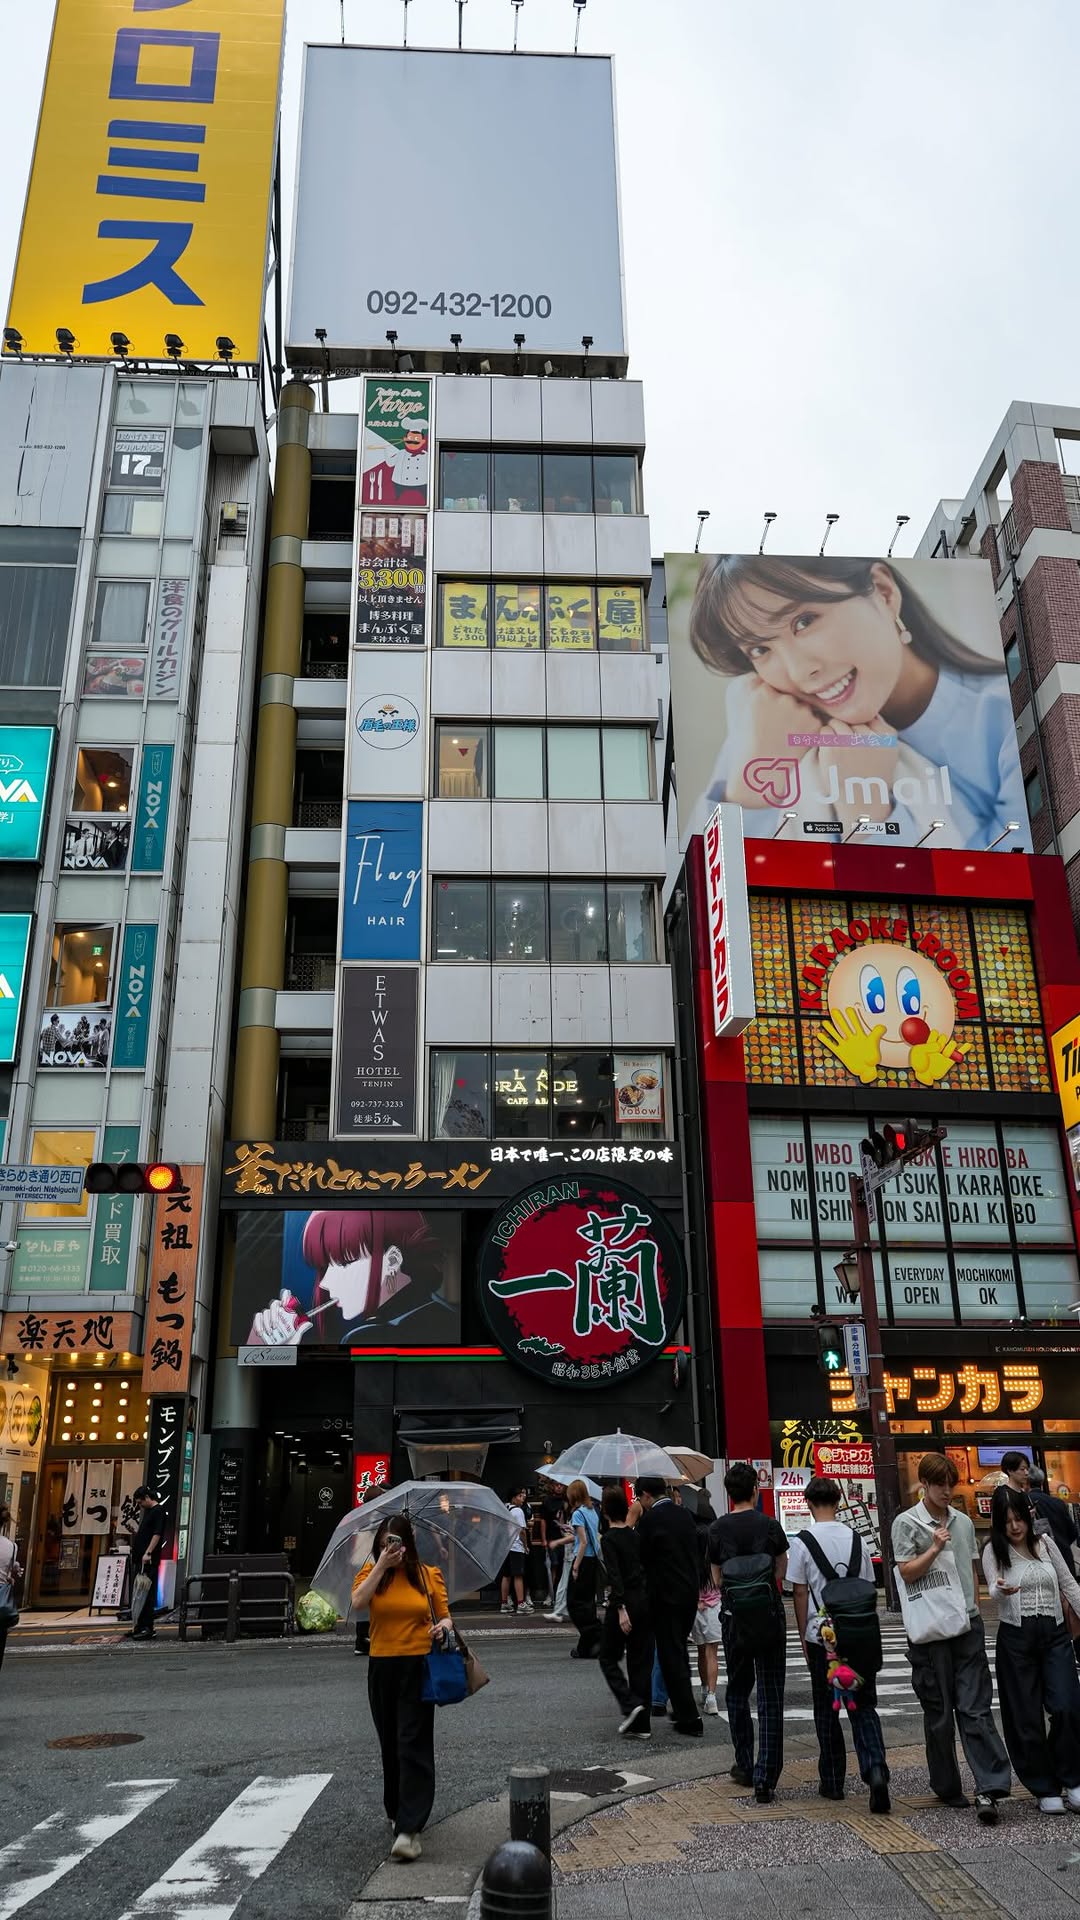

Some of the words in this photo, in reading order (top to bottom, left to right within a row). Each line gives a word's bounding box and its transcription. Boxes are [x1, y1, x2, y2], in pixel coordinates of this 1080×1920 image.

[82, 0, 220, 306] ロミス
[367, 290, 552, 319] 092-432-1200
[120, 454, 152, 476] 17
[360, 557, 408, 568] お会計は
[359, 568, 424, 592] 3,300
[155, 581, 185, 695] 洋食のグリルカジン
[358, 623, 424, 635] まんぷく屋
[144, 781, 162, 828] NOVA
[64, 855, 109, 869] NOVA
[353, 834, 422, 908] Flag
[367, 915, 406, 927] HAIR
[125, 965, 146, 1018] NOVA
[371, 975, 389, 1061] ETWAS
[41, 1051, 90, 1065] NOVA
[356, 1067, 400, 1076] HOTEL
[350, 1100, 404, 1108] 092-737-3233
[507, 1097, 529, 1105] CAFE
[353, 1112, 392, 1125] 徒歩5分
[490, 1146, 674, 1163] 日本で唯一、この店限定の味
[785, 1142, 852, 1165] JUMBO
[957, 1146, 1029, 1169] HIROBA
[0, 1168, 82, 1184] きらめき通り西口
[225, 1143, 492, 1195] 釜だれとんこつラーメン
[0, 1184, 41, 1192] irameki-dori
[44, 1185, 78, 1194] Nishiguchi
[958, 1175, 1044, 1197] KARAOKE
[101, 1149, 130, 1266] ブド買取
[492, 1181, 580, 1248] ICHIRAN
[914, 1201, 980, 1224] SAIDAI
[988, 1202, 1036, 1225] KIBO
[150, 1185, 193, 1372] 元祖もつ鍋
[488, 1204, 667, 1345] 一蘭
[894, 1267, 945, 1282] EVERYDAY
[957, 1268, 1015, 1282] MOCHIKOMI
[904, 1286, 940, 1305] OPEN
[979, 1287, 998, 1305] OK
[17, 1313, 114, 1350] 楽天地
[551, 1348, 641, 1379] 昭和35年創業
[780, 1471, 804, 1486] 24h
